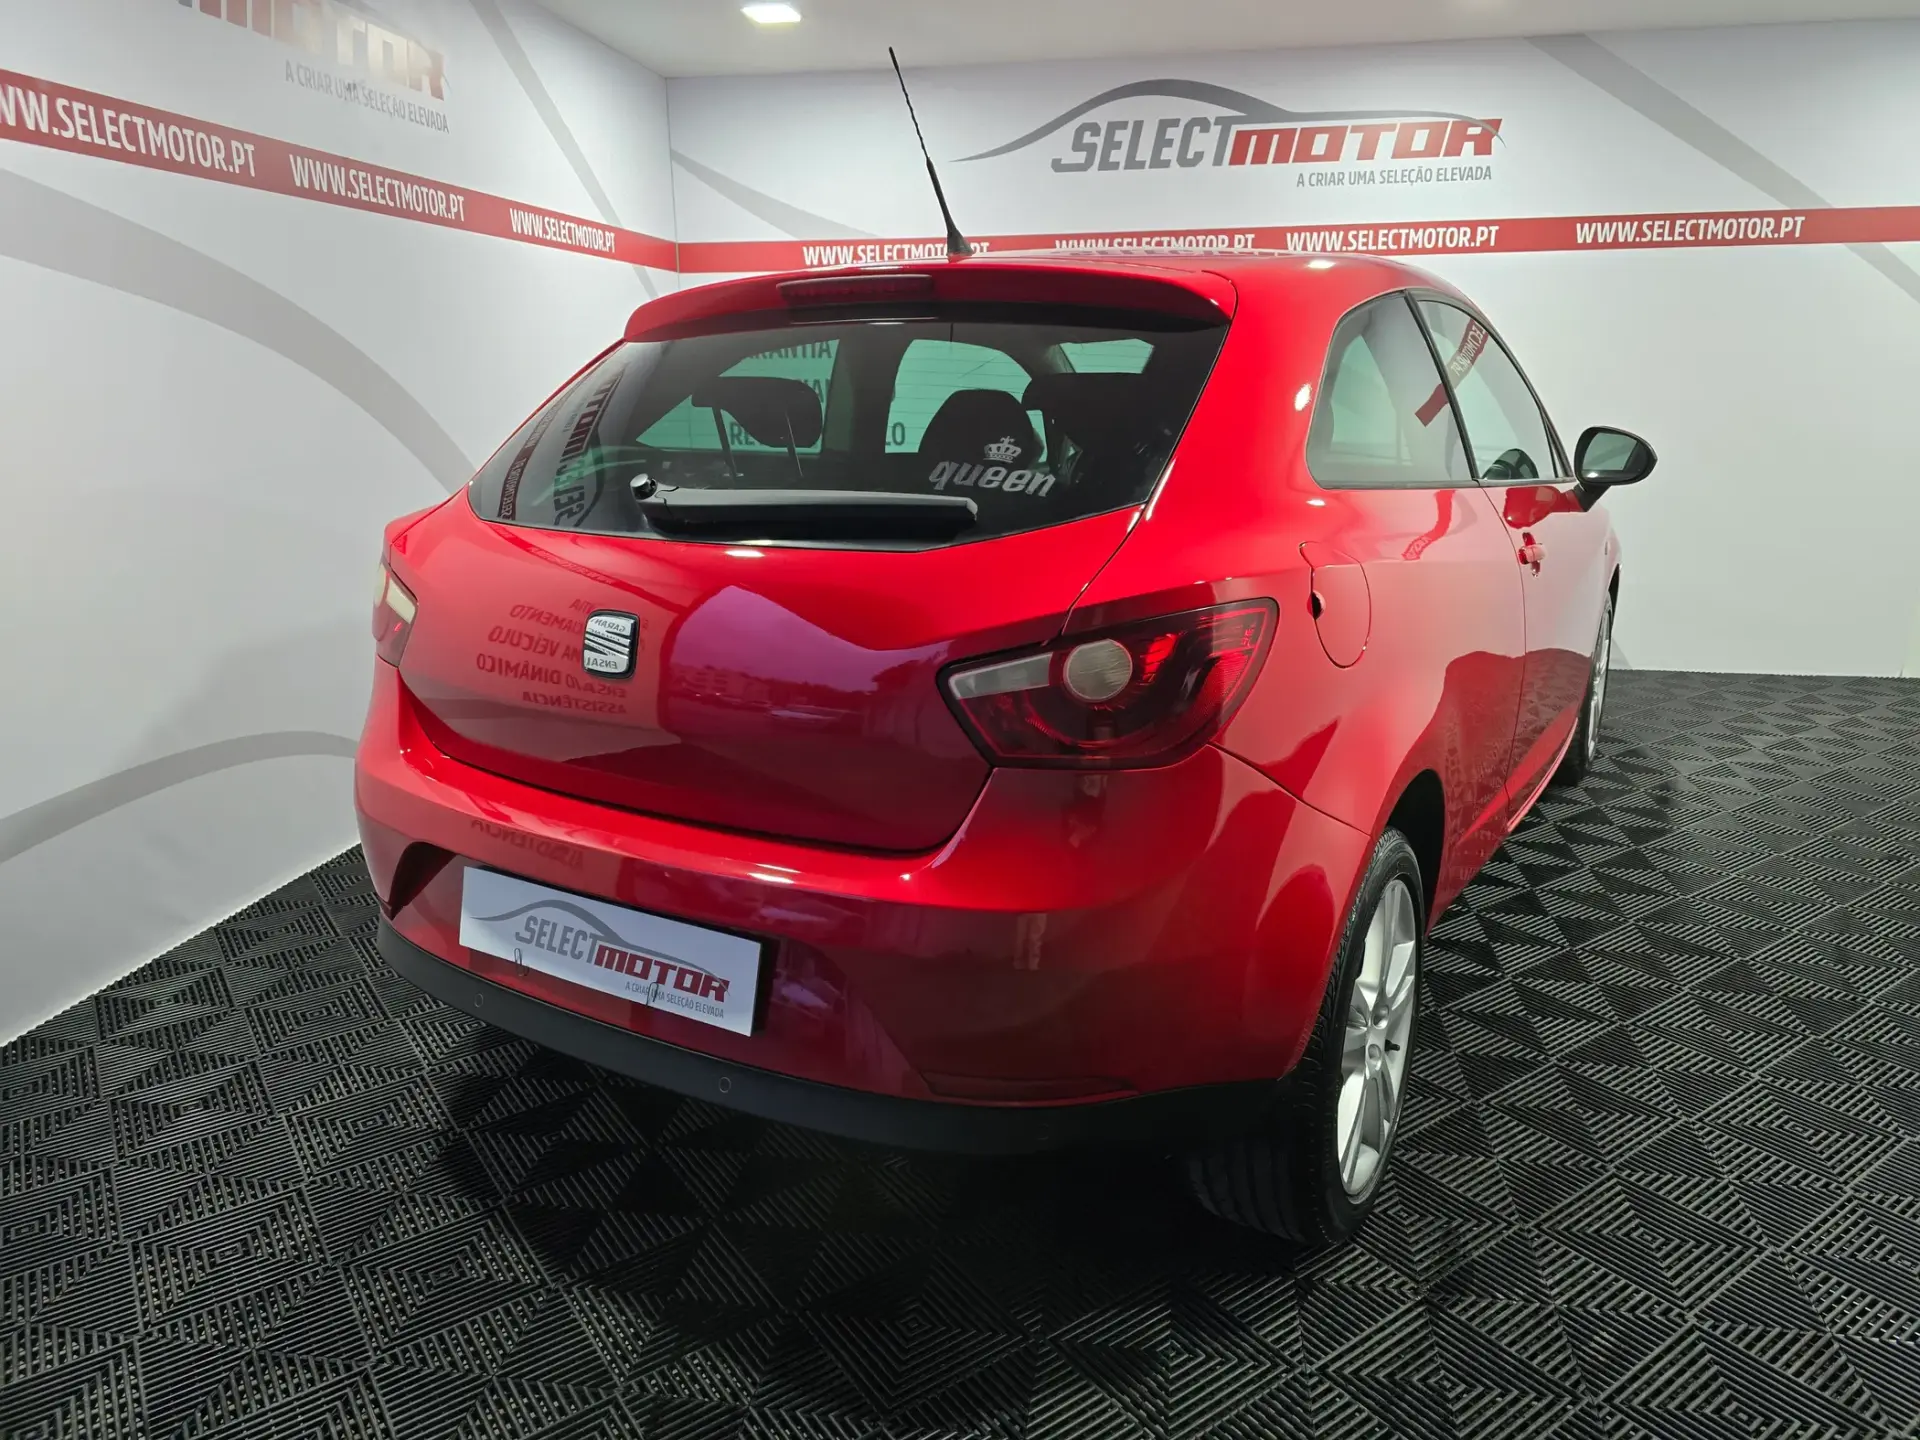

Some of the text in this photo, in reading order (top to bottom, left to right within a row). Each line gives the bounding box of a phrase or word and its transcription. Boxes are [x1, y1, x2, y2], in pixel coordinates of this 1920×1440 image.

[285, 60, 449, 134] A CRIAR UMA SELEÇÃO ELEVADA
[289, 154, 464, 221] WWW.SELECTMOTOR.PT
[1296, 165, 1492, 188] A CRIAR UMA SELEÇÃO ELEVADA
[510, 207, 616, 253] WWW.SELECTMOTOR.PT
[1286, 225, 1500, 252] WWW.SELECTMOTOR.PT
[1575, 215, 1806, 244] WWW.SELECTMOTOR.PT
[928, 461, 1057, 498] queen
[695, 1001, 724, 1018] ELEVADA
